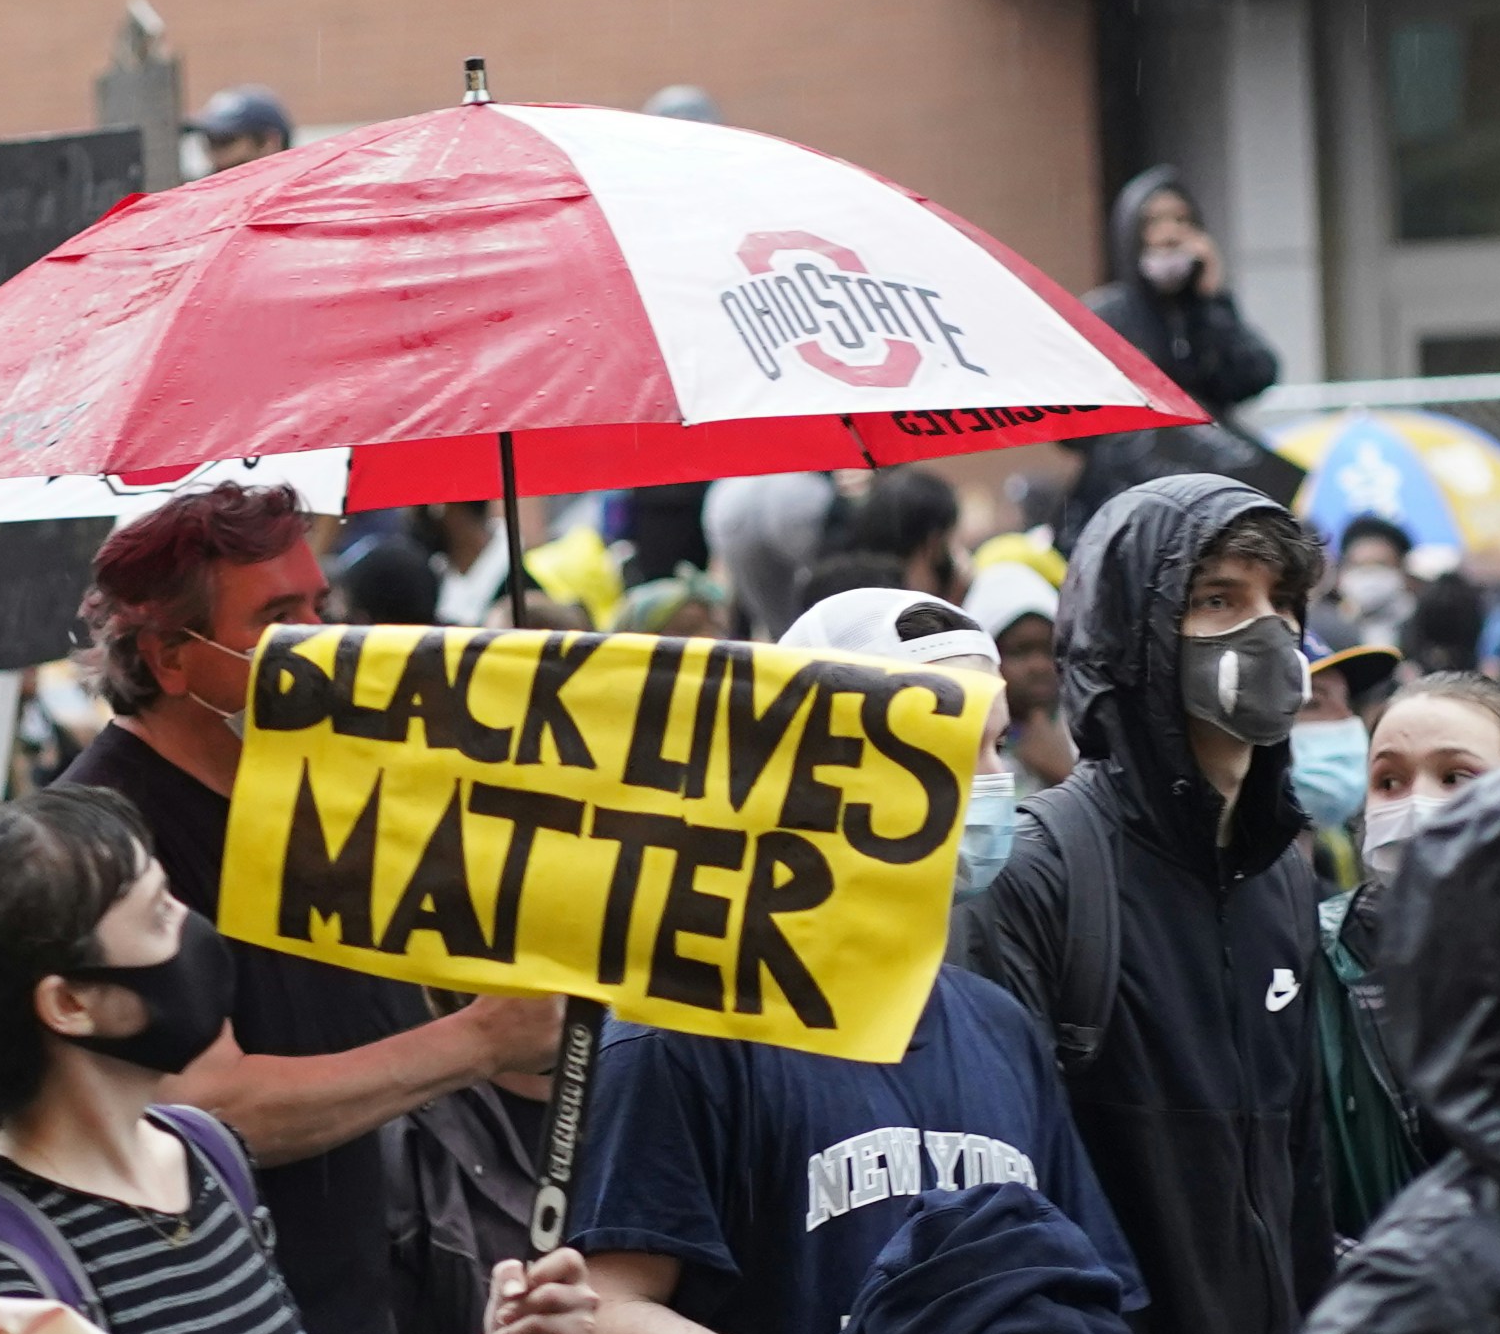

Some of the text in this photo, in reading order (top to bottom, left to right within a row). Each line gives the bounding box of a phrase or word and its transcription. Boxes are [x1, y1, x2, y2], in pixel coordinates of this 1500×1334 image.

[254, 624, 966, 864] BLACK LIVES
[277, 757, 837, 1030] MATTER
[806, 1127, 920, 1232] NEW
